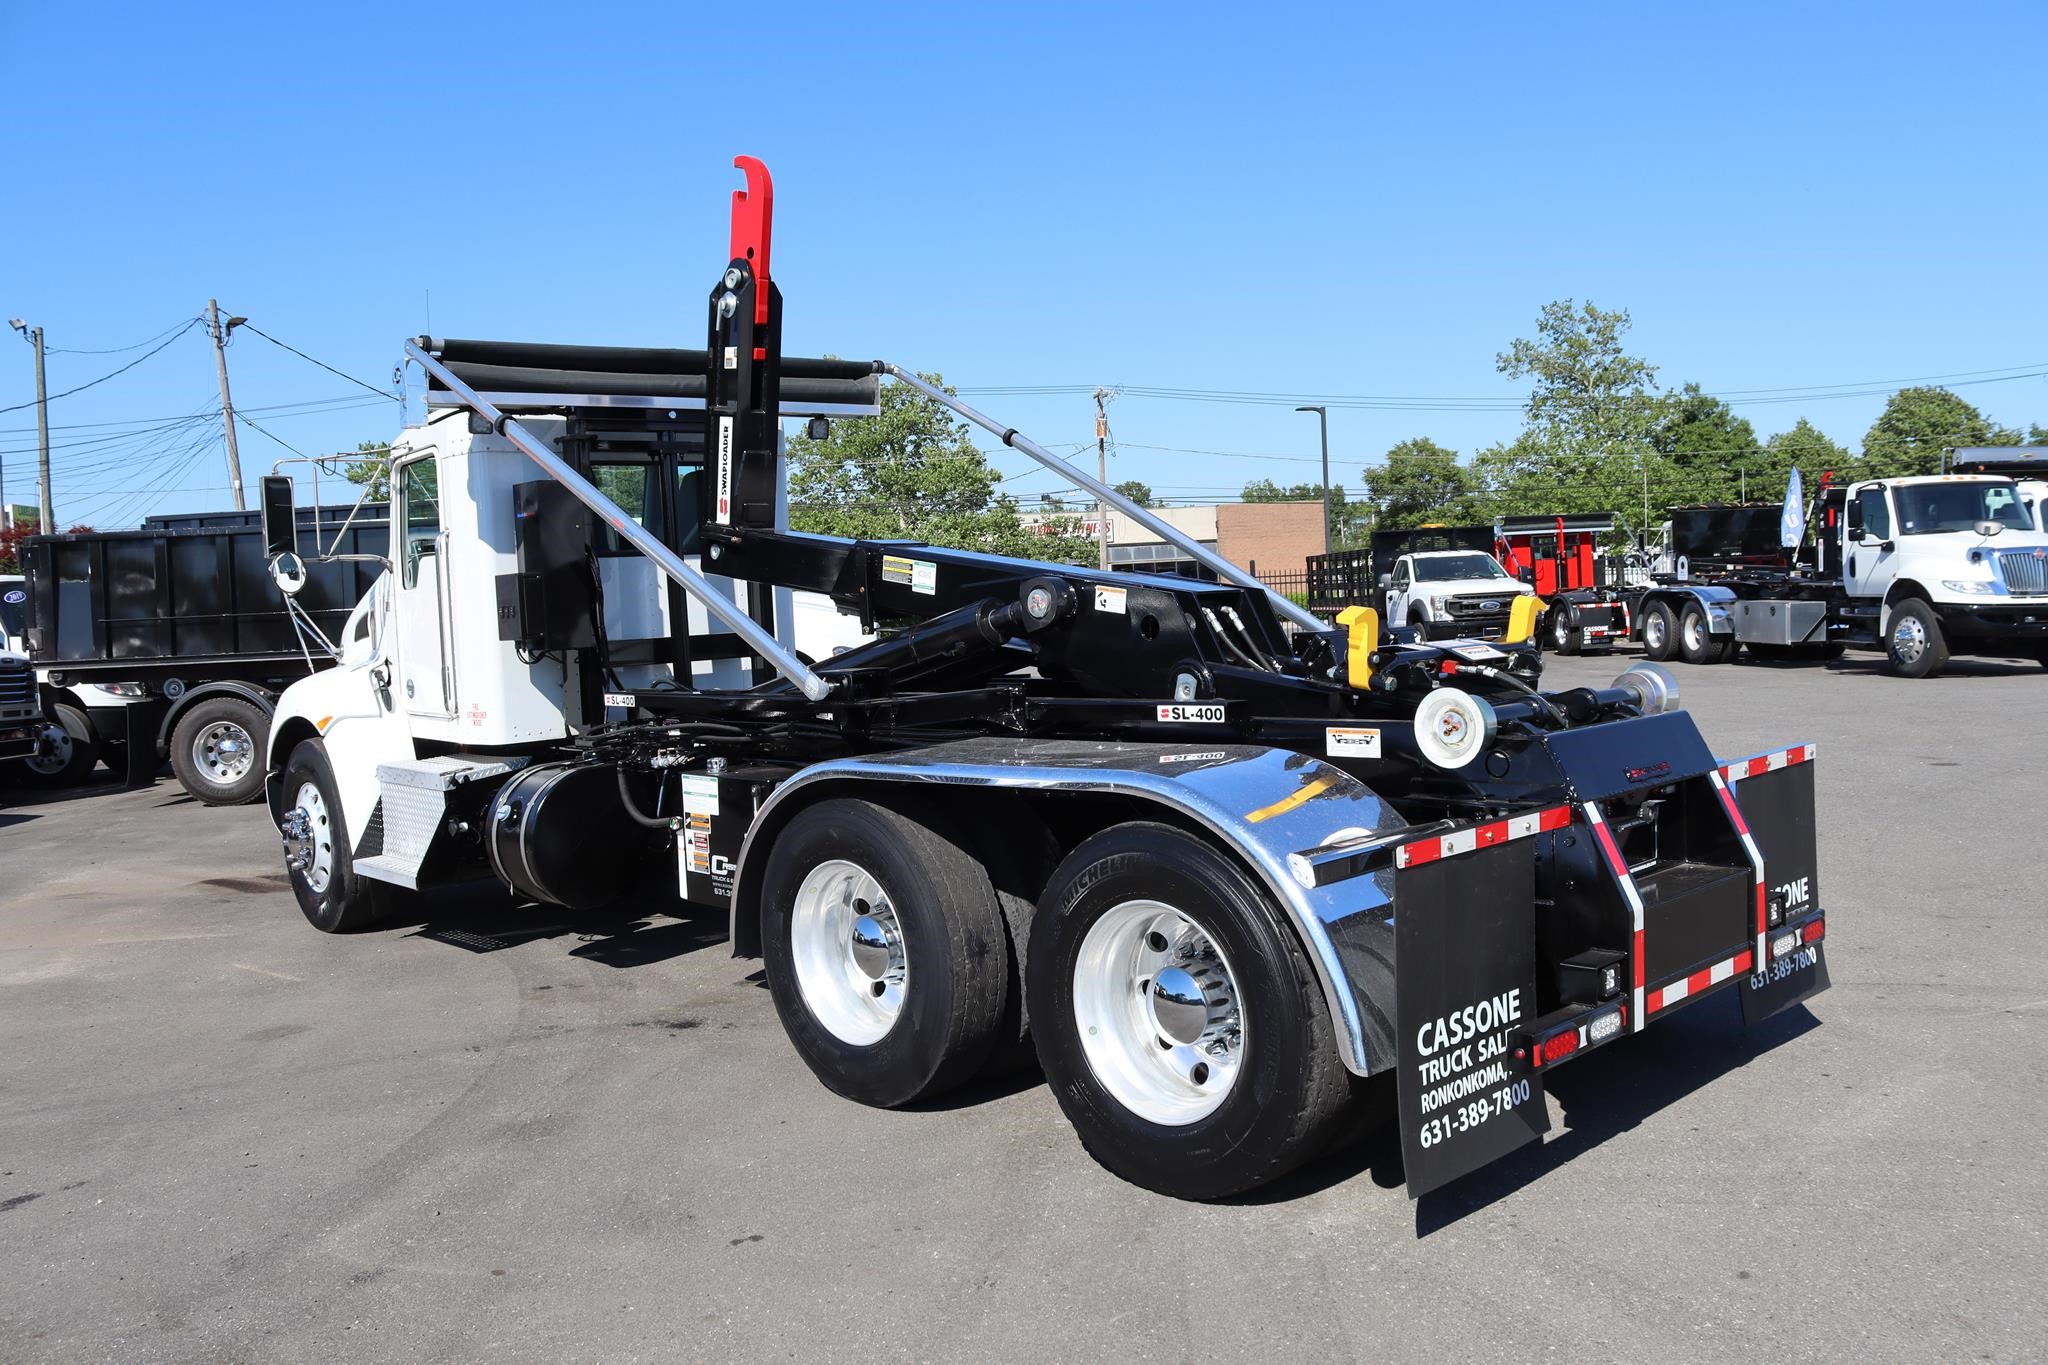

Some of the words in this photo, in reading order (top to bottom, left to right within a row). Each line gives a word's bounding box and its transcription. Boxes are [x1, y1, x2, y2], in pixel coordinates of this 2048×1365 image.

[721, 425, 729, 496] SWAPLOADER
[610, 695, 635, 706] SL-400
[1172, 702, 1223, 721] SL-400
[1751, 946, 1817, 990] 631-389-7800
[1417, 988, 1521, 1057] CASSONE
[1418, 1045, 1473, 1086] TRUCK
[1478, 1023, 1521, 1062] SAL
[1420, 1079, 1530, 1149] 631-389-7800
[1421, 1061, 1508, 1114] RONKONKOMA,
